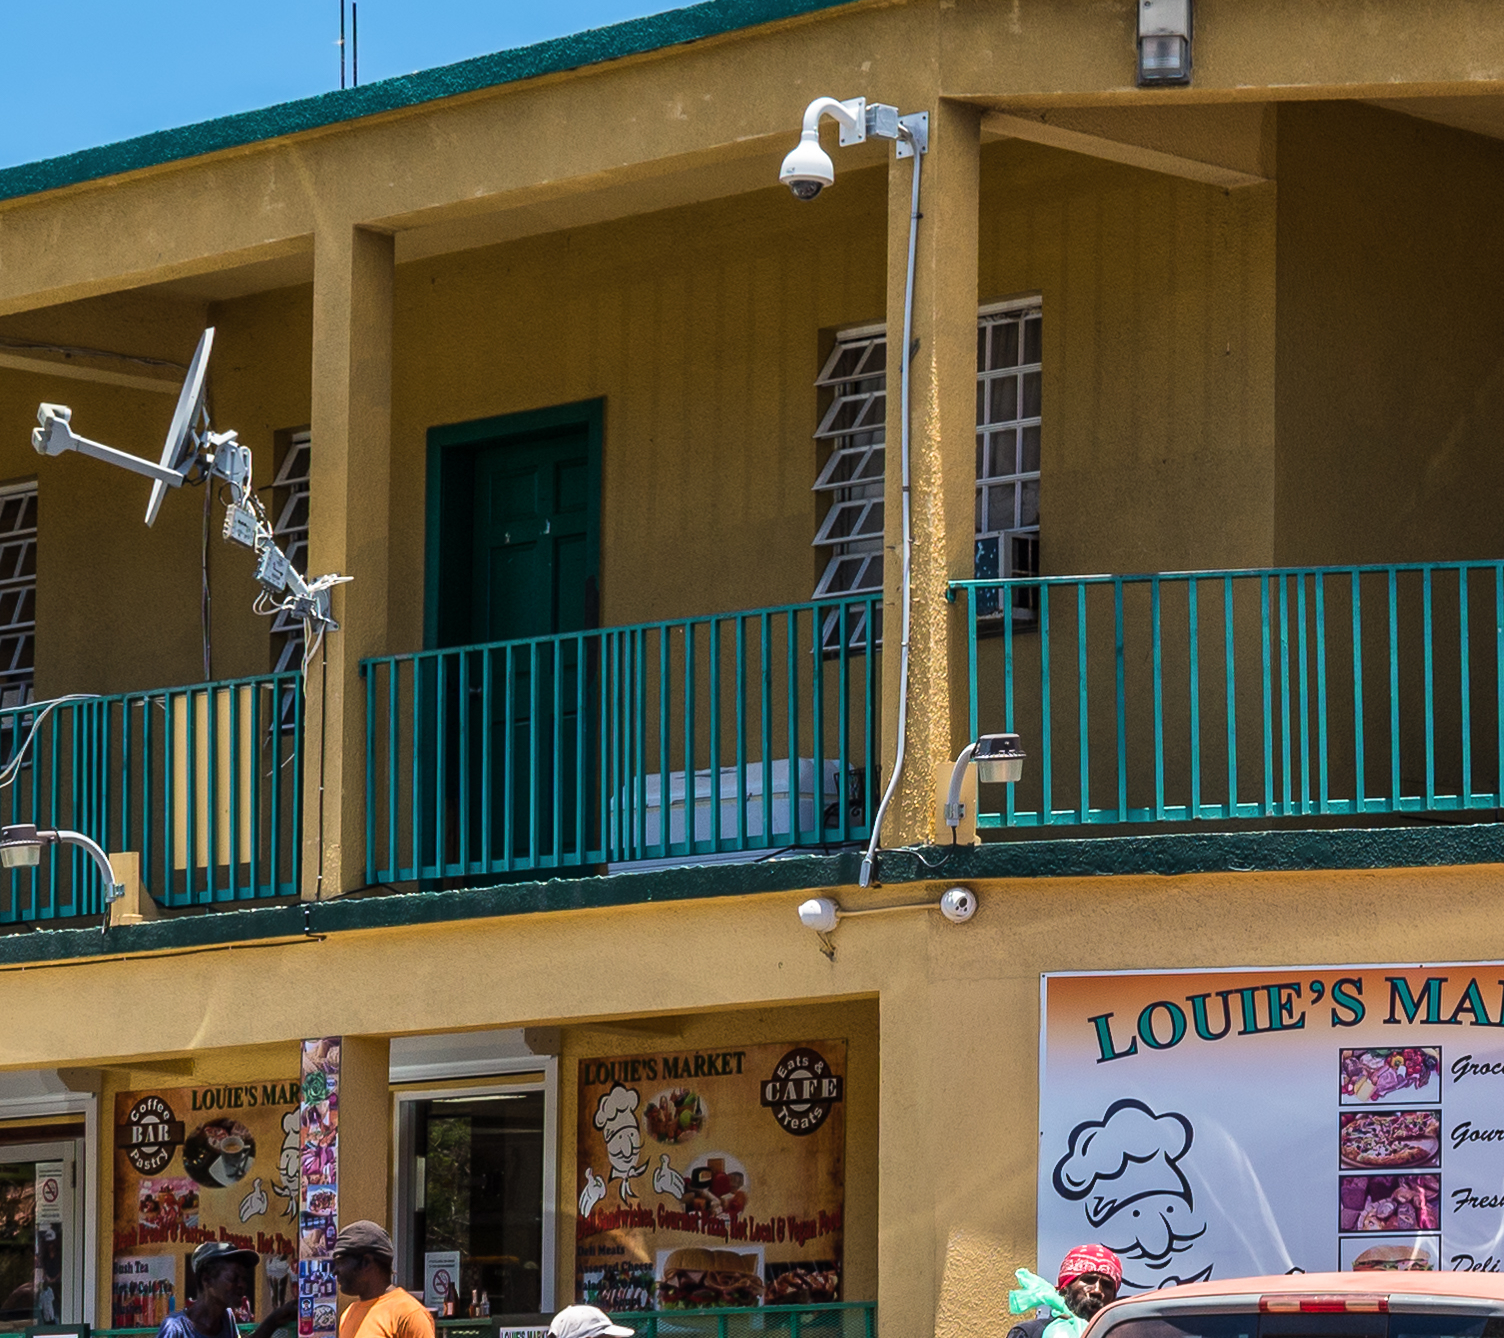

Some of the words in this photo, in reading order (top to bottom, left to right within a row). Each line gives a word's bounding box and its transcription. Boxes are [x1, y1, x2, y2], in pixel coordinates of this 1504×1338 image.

[1088, 977, 1365, 1065] LOUIE'S
[584, 1060, 657, 1086] LOUIE'S
[662, 1051, 745, 1080] MARKET
[777, 1055, 809, 1079] Eats
[191, 1085, 258, 1111] LOUIE'S
[765, 1078, 838, 1102] CAFE
[130, 1098, 171, 1123] Coffee
[777, 1105, 824, 1130] Treats
[131, 1124, 171, 1144] BAR
[130, 1147, 168, 1170] Pastry
[1450, 1254, 1502, 1274] Deli
